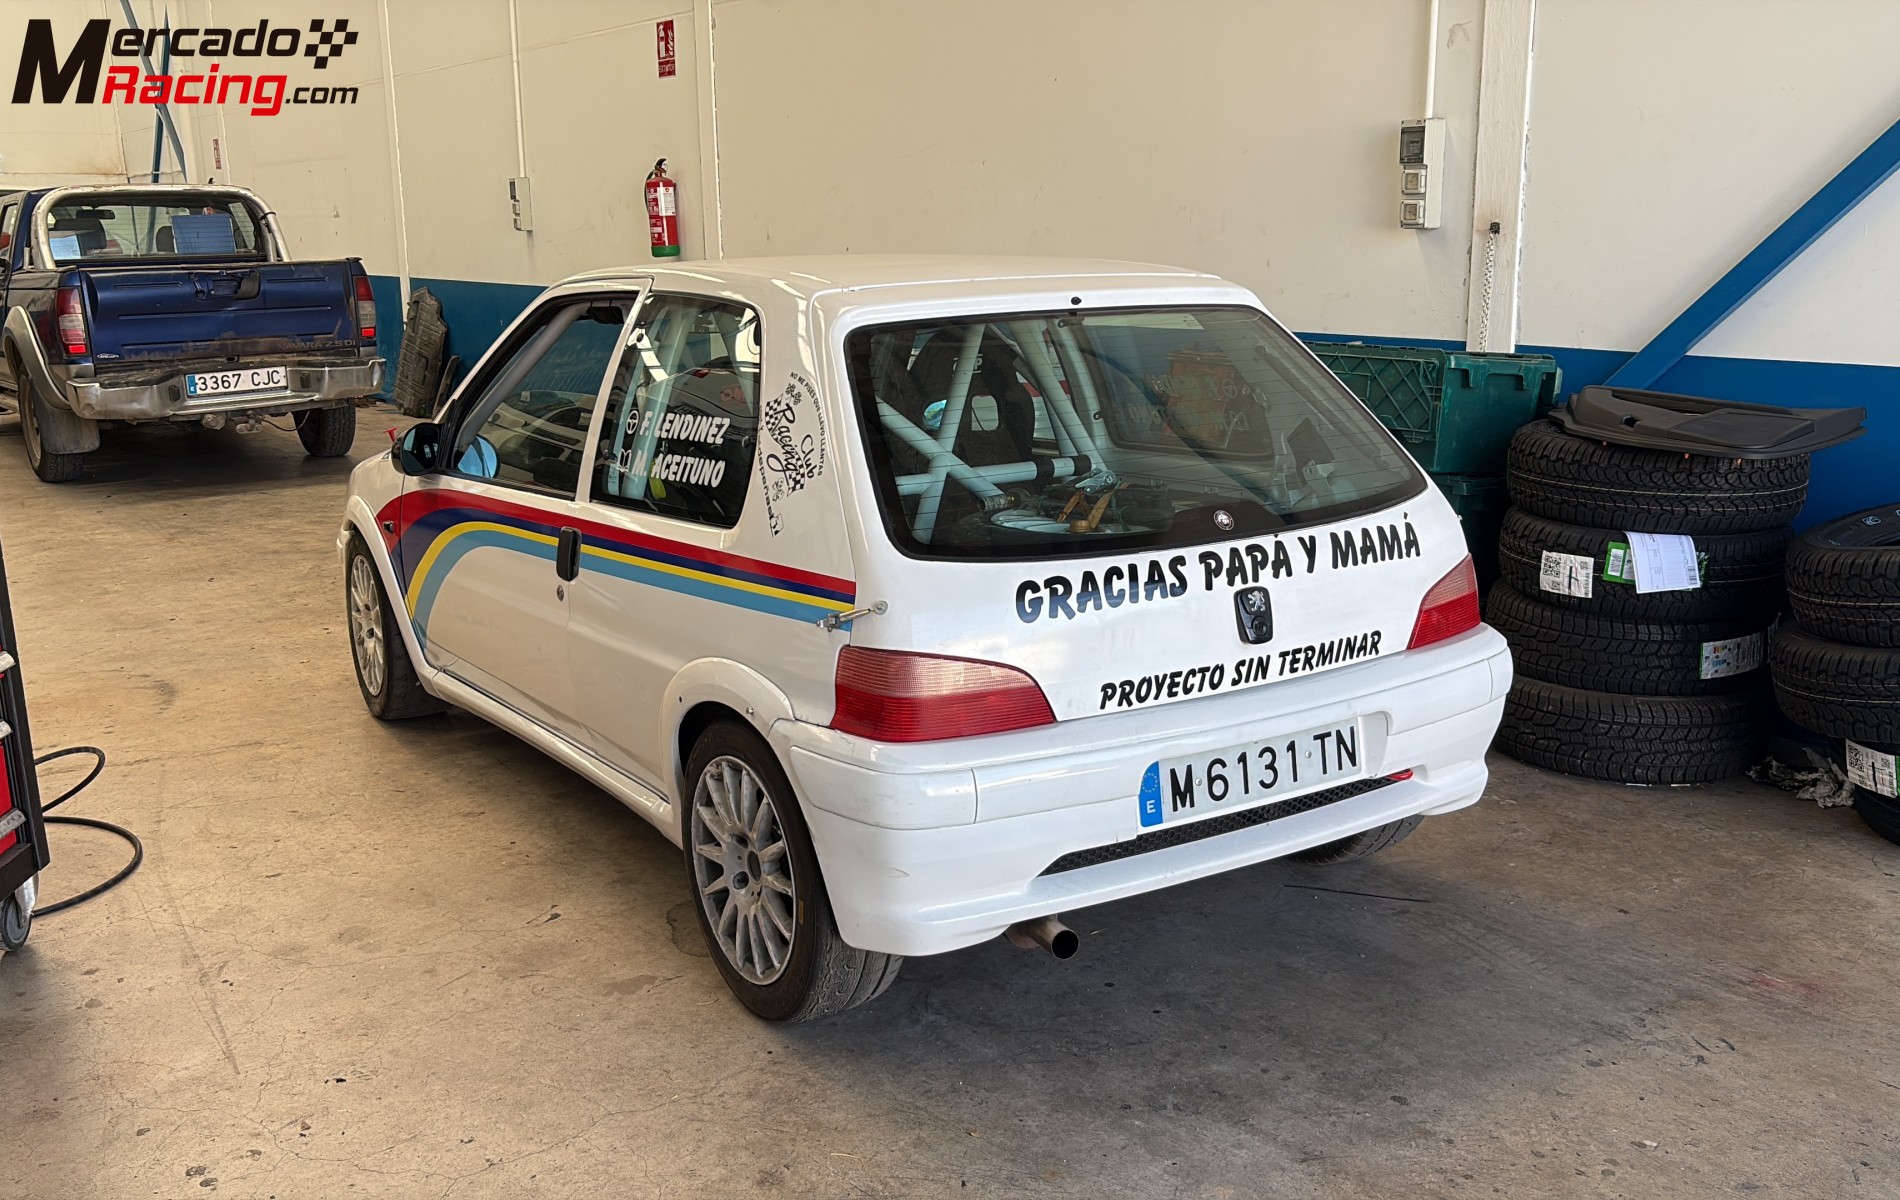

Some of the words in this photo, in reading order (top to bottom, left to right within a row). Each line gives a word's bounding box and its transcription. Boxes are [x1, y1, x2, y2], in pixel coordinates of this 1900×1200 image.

[278, 341, 323, 350] NAVARA
[198, 373, 242, 391] 3367
[251, 369, 281, 387] CJC
[790, 372, 799, 380] NO
[797, 376, 806, 386] ME
[804, 382, 817, 399] PISES
[813, 397, 821, 412] QUE
[639, 411, 654, 437] F.
[654, 412, 731, 445] LENDINEZ
[817, 412, 826, 437] LLEVO
[766, 402, 799, 487] Racing
[800, 433, 818, 479] Club
[817, 437, 826, 477] LLANTAS
[631, 449, 647, 477] M.
[650, 453, 726, 488] ACEITUNO
[1015, 555, 1188, 623] GRACIAS
[1199, 534, 1293, 591] PAPÁ
[1297, 536, 1317, 574] Y
[1329, 512, 1421, 570] MAMÁ
[1100, 663, 1225, 710] PROYECTO
[1231, 654, 1271, 687] SIN
[1278, 630, 1382, 677] TERMINAR
[1169, 764, 1195, 812] M
[1206, 739, 1299, 802] 6131
[1313, 725, 1358, 775] TN
[1146, 799, 1156, 814] E
